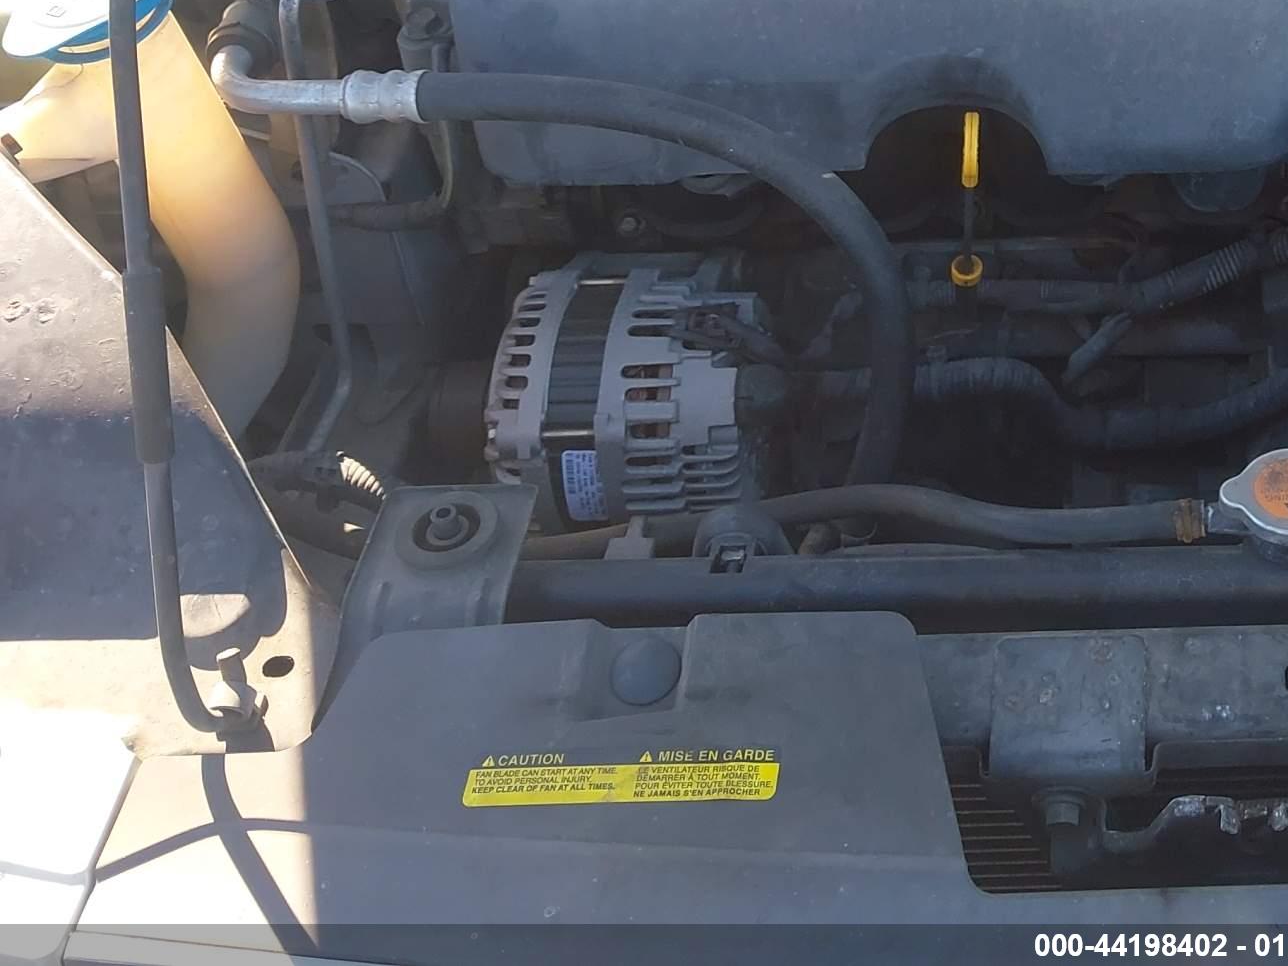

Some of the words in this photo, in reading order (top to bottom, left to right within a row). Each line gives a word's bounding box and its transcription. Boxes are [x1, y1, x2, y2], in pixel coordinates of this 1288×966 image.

[498, 754, 565, 767] CAUTION
[658, 750, 695, 762] MISE
[698, 750, 719, 762] EN
[722, 749, 775, 762] GARDE
[475, 770, 492, 779] FAN
[493, 769, 520, 778] BLADE
[521, 768, 540, 777] CAN
[540, 768, 567, 776] START
[579, 767, 597, 775] ANY
[651, 765, 710, 774] VENTILATEUR
[712, 764, 746, 773] RISQUE
[747, 764, 760, 772] DE
[475, 778, 486, 786] TO
[486, 777, 513, 786] AVOID
[514, 776, 560, 785] PERSONAL
[697, 773, 719, 781] TOUT
[472, 786, 494, 794] KEEP
[495, 785, 525, 793] CLEAR
[526, 784, 539, 792] OF
[539, 784, 557, 792] FAN
[569, 783, 586, 791] ALL
[634, 782, 659, 790] POUR
[696, 780, 724, 788] TOUTE
[633, 790, 647, 798] NE
[647, 789, 681, 797] JAMAIS
[682, 789, 704, 797] S'EN
[705, 787, 760, 796] APPROCHER
